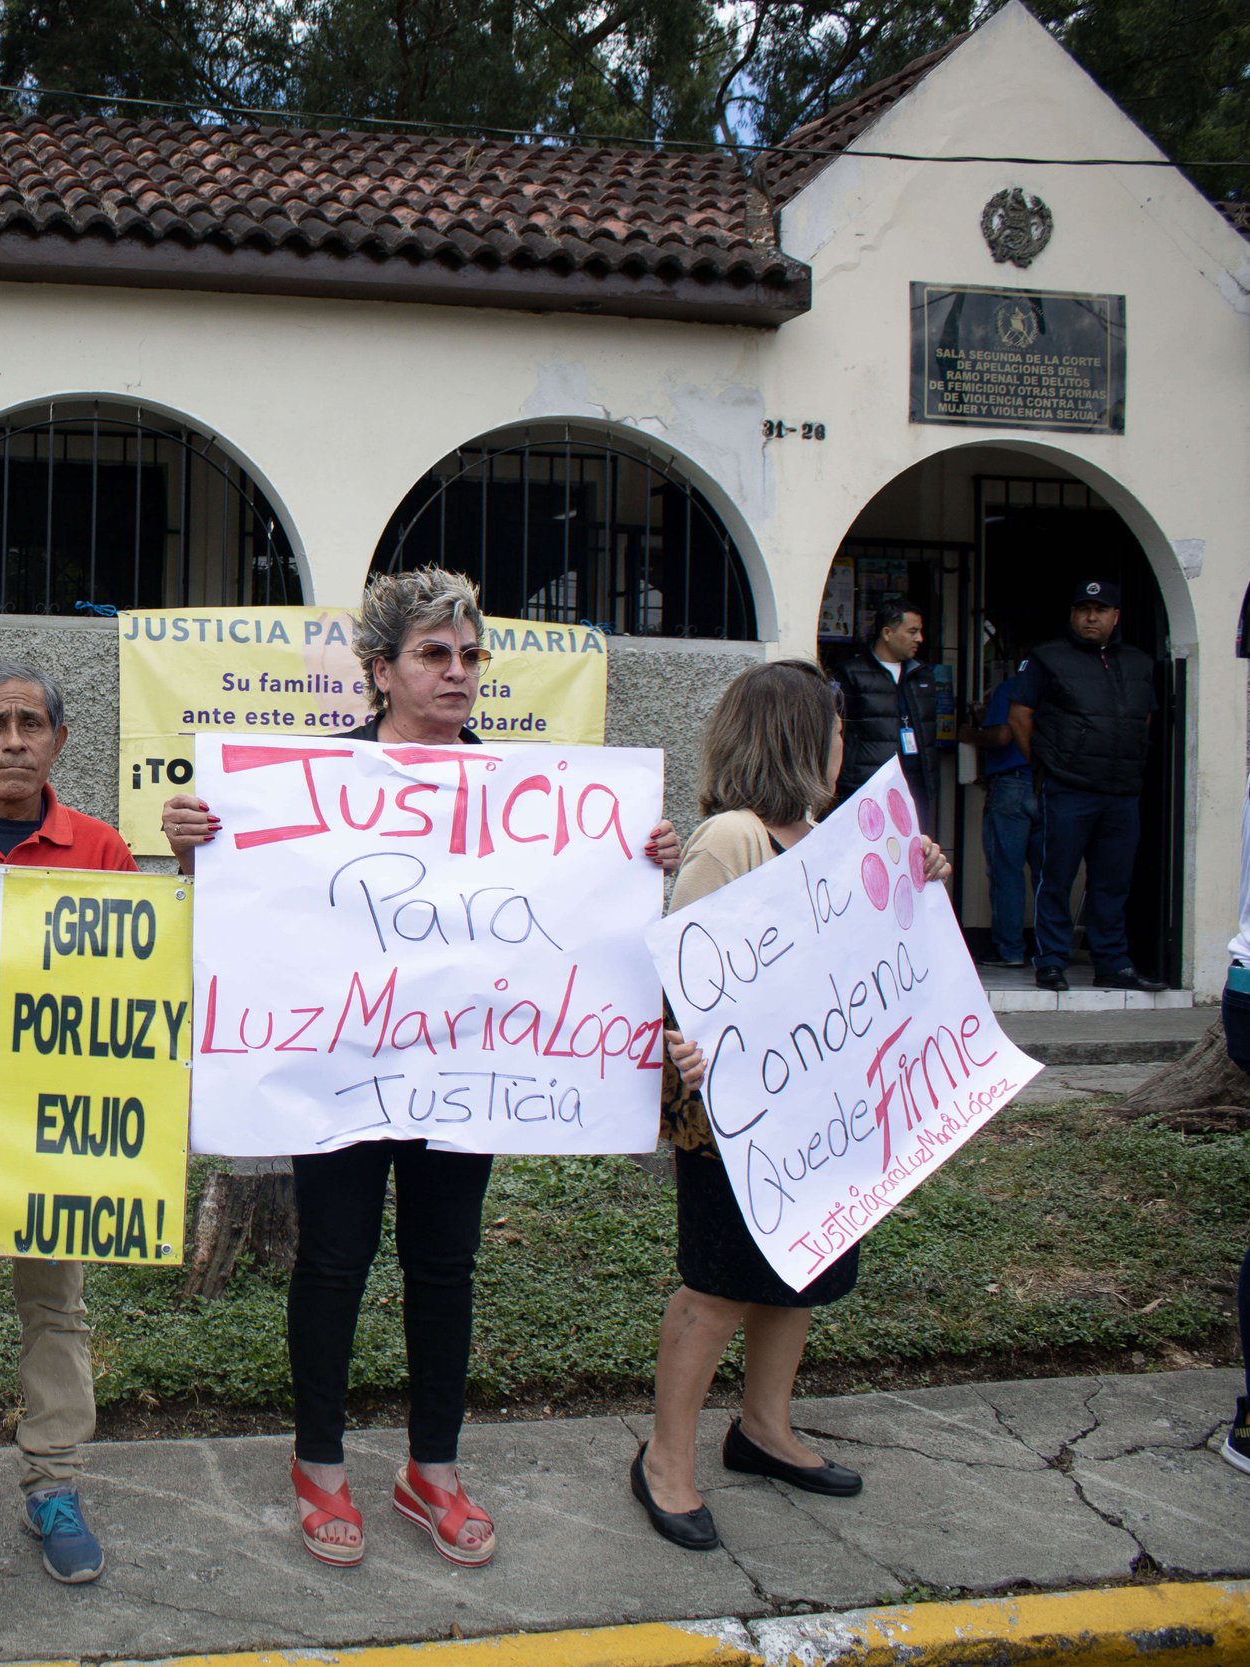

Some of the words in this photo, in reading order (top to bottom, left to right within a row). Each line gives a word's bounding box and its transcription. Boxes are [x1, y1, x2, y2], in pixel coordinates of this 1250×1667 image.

[936, 348, 965, 359] SALA
[969, 350, 1022, 363] SEGUNDA
[1026, 354, 1040, 364] DE
[1044, 355, 1059, 365] LA
[1062, 356, 1101, 367] CORTE
[957, 360, 972, 370] DE
[975, 361, 1055, 375] APELACIONES
[1058, 366, 1080, 377] DEL
[929, 380, 945, 391] DE
[948, 381, 1007, 395] FEMICIDIO
[1008, 385, 1017, 395] Y
[1018, 386, 1056, 397] OTRAS
[1059, 388, 1107, 400] FORMAS
[946, 371, 980, 382] RAMO
[983, 372, 1020, 385] PENAL
[1023, 375, 1039, 386] DE
[1042, 377, 1091, 388] DELITOS
[937, 403, 979, 414] MUJER
[980, 405, 988, 415] Y
[991, 406, 1054, 419] VIOLENCIA
[1056, 410, 1101, 421] SEXUAL
[943, 392, 959, 403] DE
[962, 394, 1023, 406] VIOLENCIA
[1026, 397, 1075, 409] CONTRA
[1078, 400, 1093, 411] LA
[124, 617, 290, 645] JUSTICIA
[304, 621, 348, 646] PA
[222, 672, 250, 692] Su
[259, 673, 343, 694] familia
[182, 708, 236, 725] ante
[246, 710, 295, 726] este
[304, 711, 355, 728] acto
[465, 711, 547, 731] obarde
[132, 758, 193, 790] ¡TO
[329, 851, 564, 952] Para
[42, 896, 156, 971] ¡GRITO
[677, 920, 795, 1012] Que
[800, 859, 852, 934] la
[12, 993, 83, 1056] POR
[89, 997, 157, 1059] LUZ
[163, 1000, 188, 1061] Y
[706, 940, 930, 1139] Condena
[35, 1093, 146, 1159] EXIJIO
